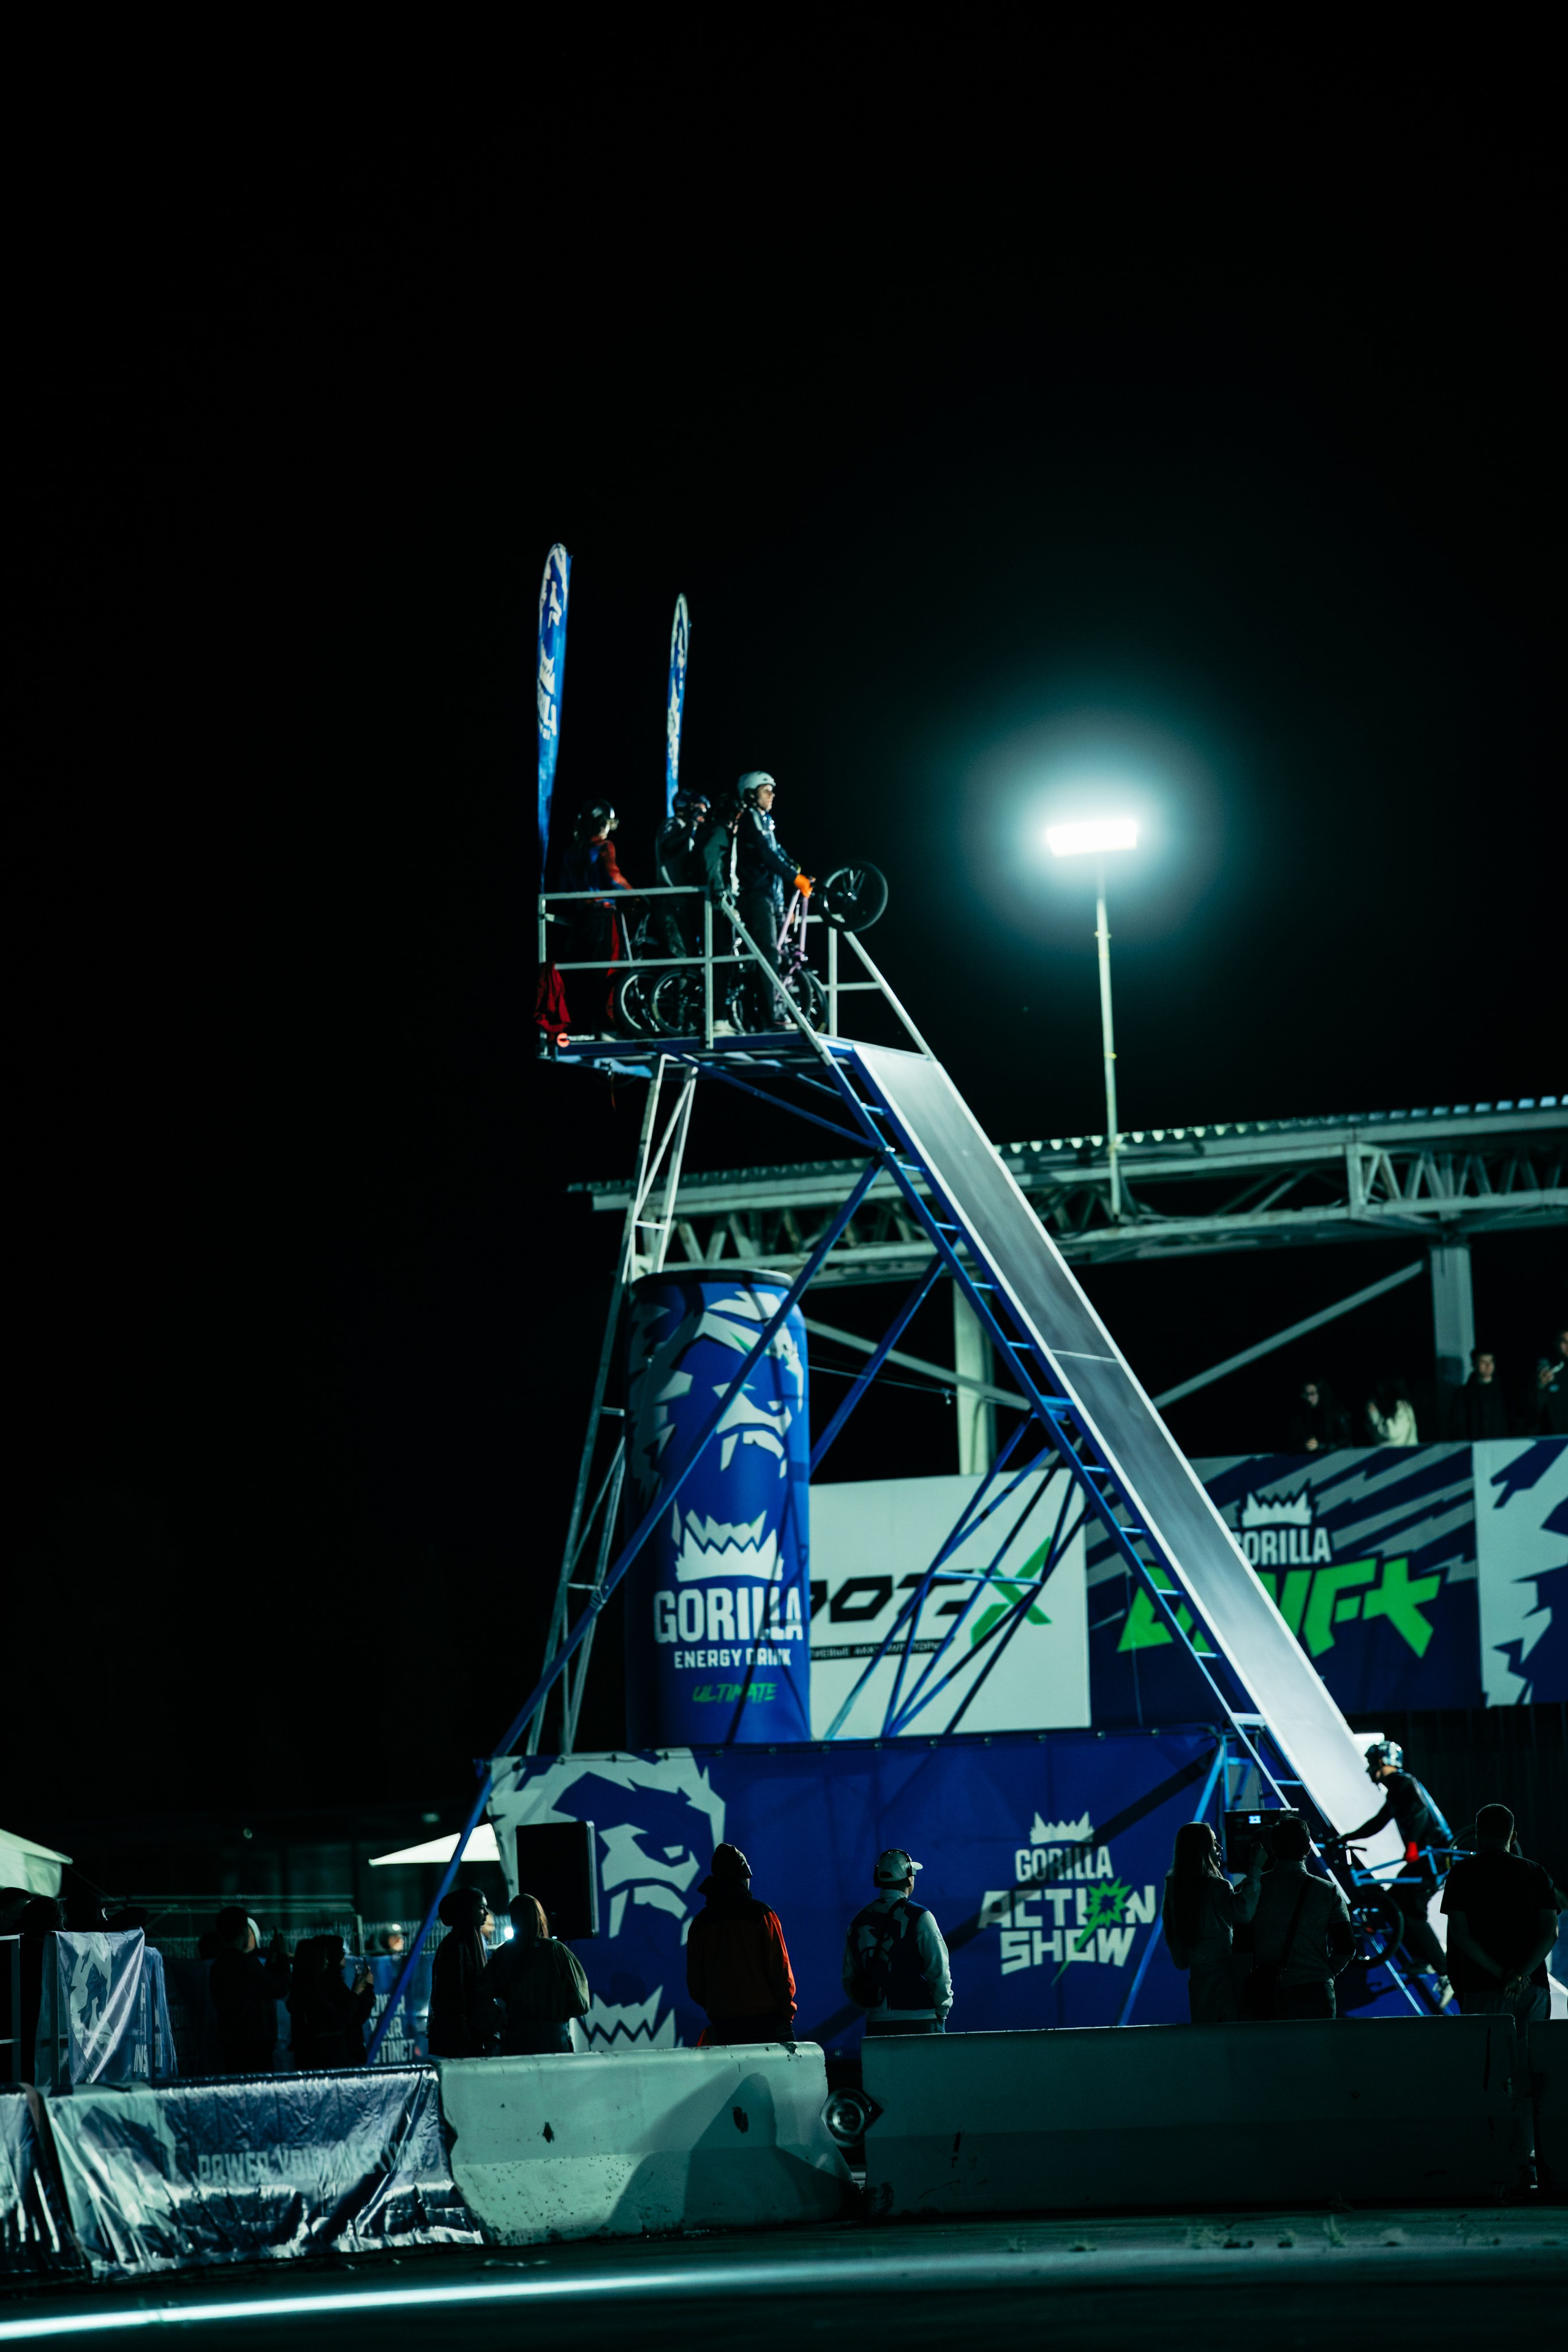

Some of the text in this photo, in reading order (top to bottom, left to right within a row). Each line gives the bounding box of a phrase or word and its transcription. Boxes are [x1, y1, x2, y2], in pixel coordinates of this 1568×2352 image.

[654, 1586, 804, 1643] GORILLA
[674, 1649, 742, 1668] ENERGY
[745, 1648, 791, 1666] DRINK
[692, 1683, 778, 1703] ULTIMATE
[1014, 1845, 1114, 1882] GORILLA
[1000, 1927, 1136, 1976] SHOW
